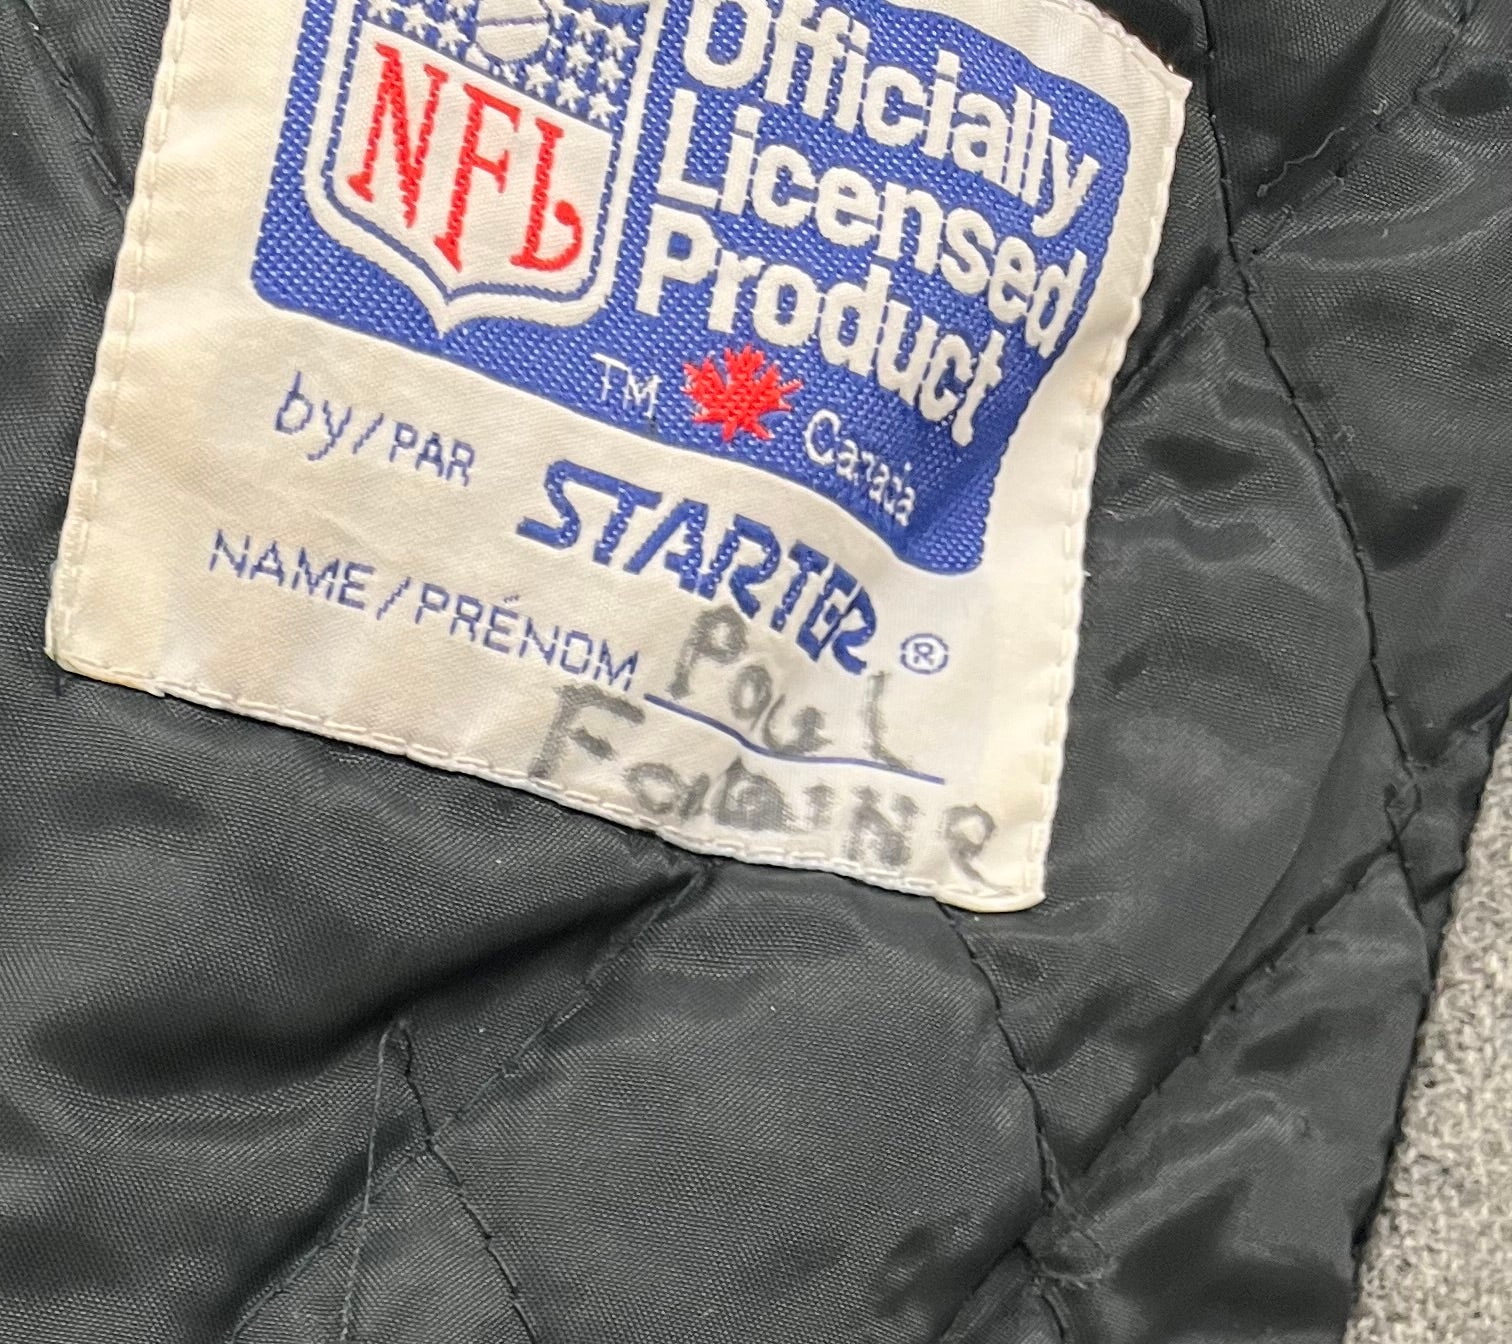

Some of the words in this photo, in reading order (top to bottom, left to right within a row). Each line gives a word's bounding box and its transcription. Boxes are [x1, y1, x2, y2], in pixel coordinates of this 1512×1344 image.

[348, 42, 584, 271] NFL
[656, 91, 1088, 358] Licensed
[684, 0, 1101, 239] Officially
[592, 353, 661, 421] TM
[635, 204, 1007, 448] Product
[516, 459, 877, 675] STARTER
